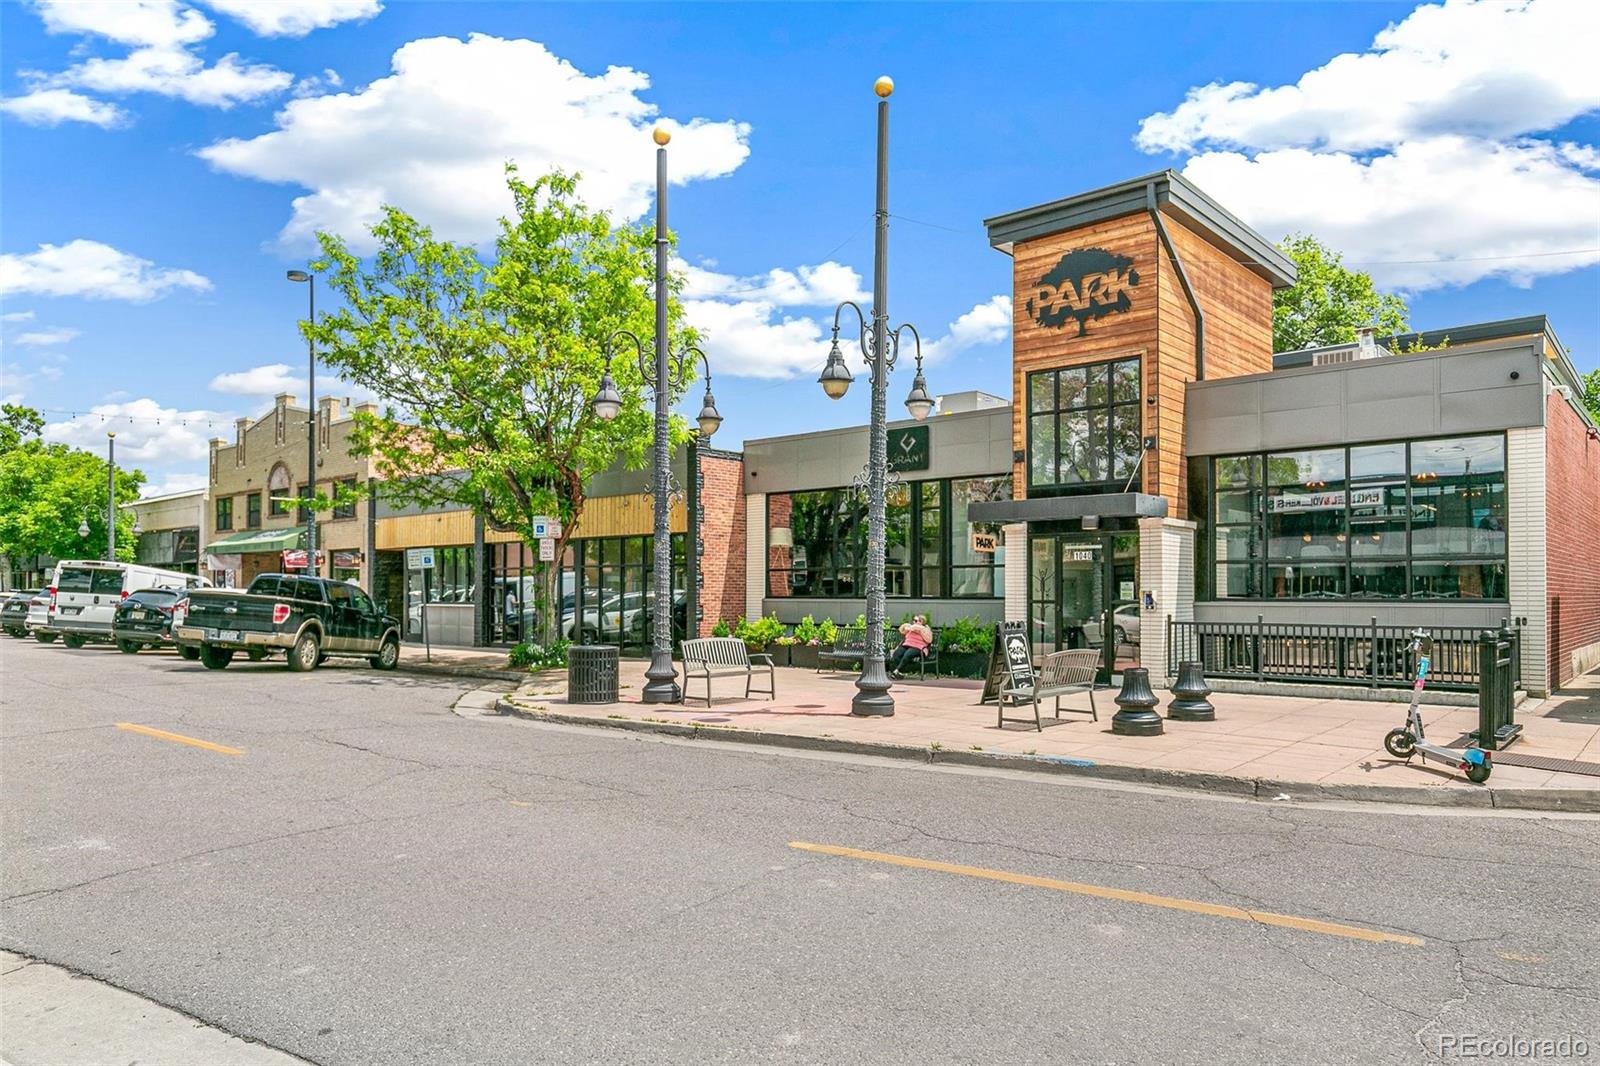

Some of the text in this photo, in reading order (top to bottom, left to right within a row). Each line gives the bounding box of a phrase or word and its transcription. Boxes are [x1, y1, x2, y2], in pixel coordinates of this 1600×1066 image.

[1031, 266, 1134, 318] PARK
[975, 536, 995, 549] PARK
[1074, 551, 1092, 560] 1040
